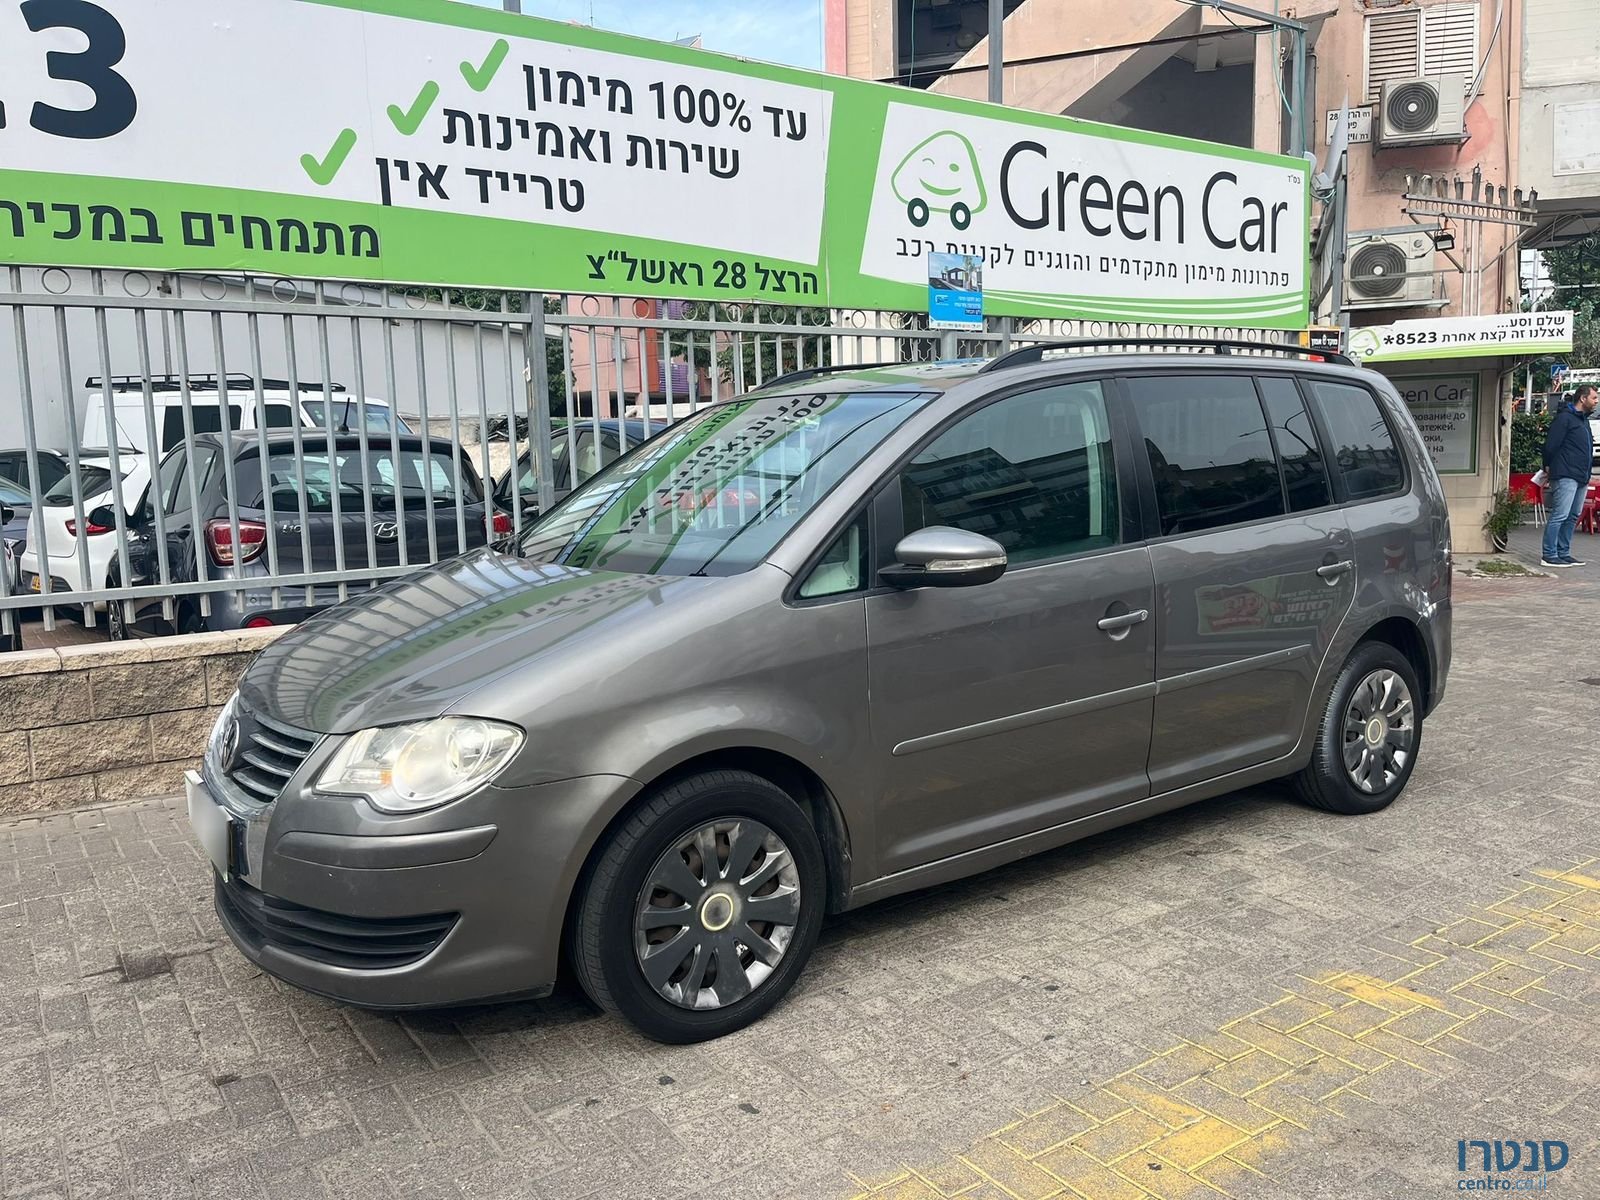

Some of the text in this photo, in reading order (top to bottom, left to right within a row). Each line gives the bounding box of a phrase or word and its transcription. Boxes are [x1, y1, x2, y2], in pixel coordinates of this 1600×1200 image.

[522, 63, 807, 141] עד 100% מימון
[1329, 113, 1339, 121] 28
[442, 107, 740, 180] שירות ואמינות
[375, 156, 586, 213] טרייד אין
[999, 140, 1288, 254] Green Car
[0, 199, 380, 259] מתמחים במכיר
[1024, 249, 1091, 272] והוגנים
[1099, 256, 1178, 281] מתקדמים
[712, 260, 747, 290] 28
[754, 262, 818, 295] הרצל
[1184, 263, 1226, 285] מימון
[1231, 267, 1290, 288] פתרונות
[1536, 315, 1566, 327] שלם
[1442, 332, 1476, 343] אחרת
[1480, 330, 1507, 342] קצת
[1511, 328, 1525, 339] זה
[1529, 327, 1566, 338] אצלנו
[1434, 384, 1469, 401] Car
[1413, 412, 1466, 422] рование до
[1419, 422, 1456, 431] атежей.
[1424, 435, 1443, 443] оки,
